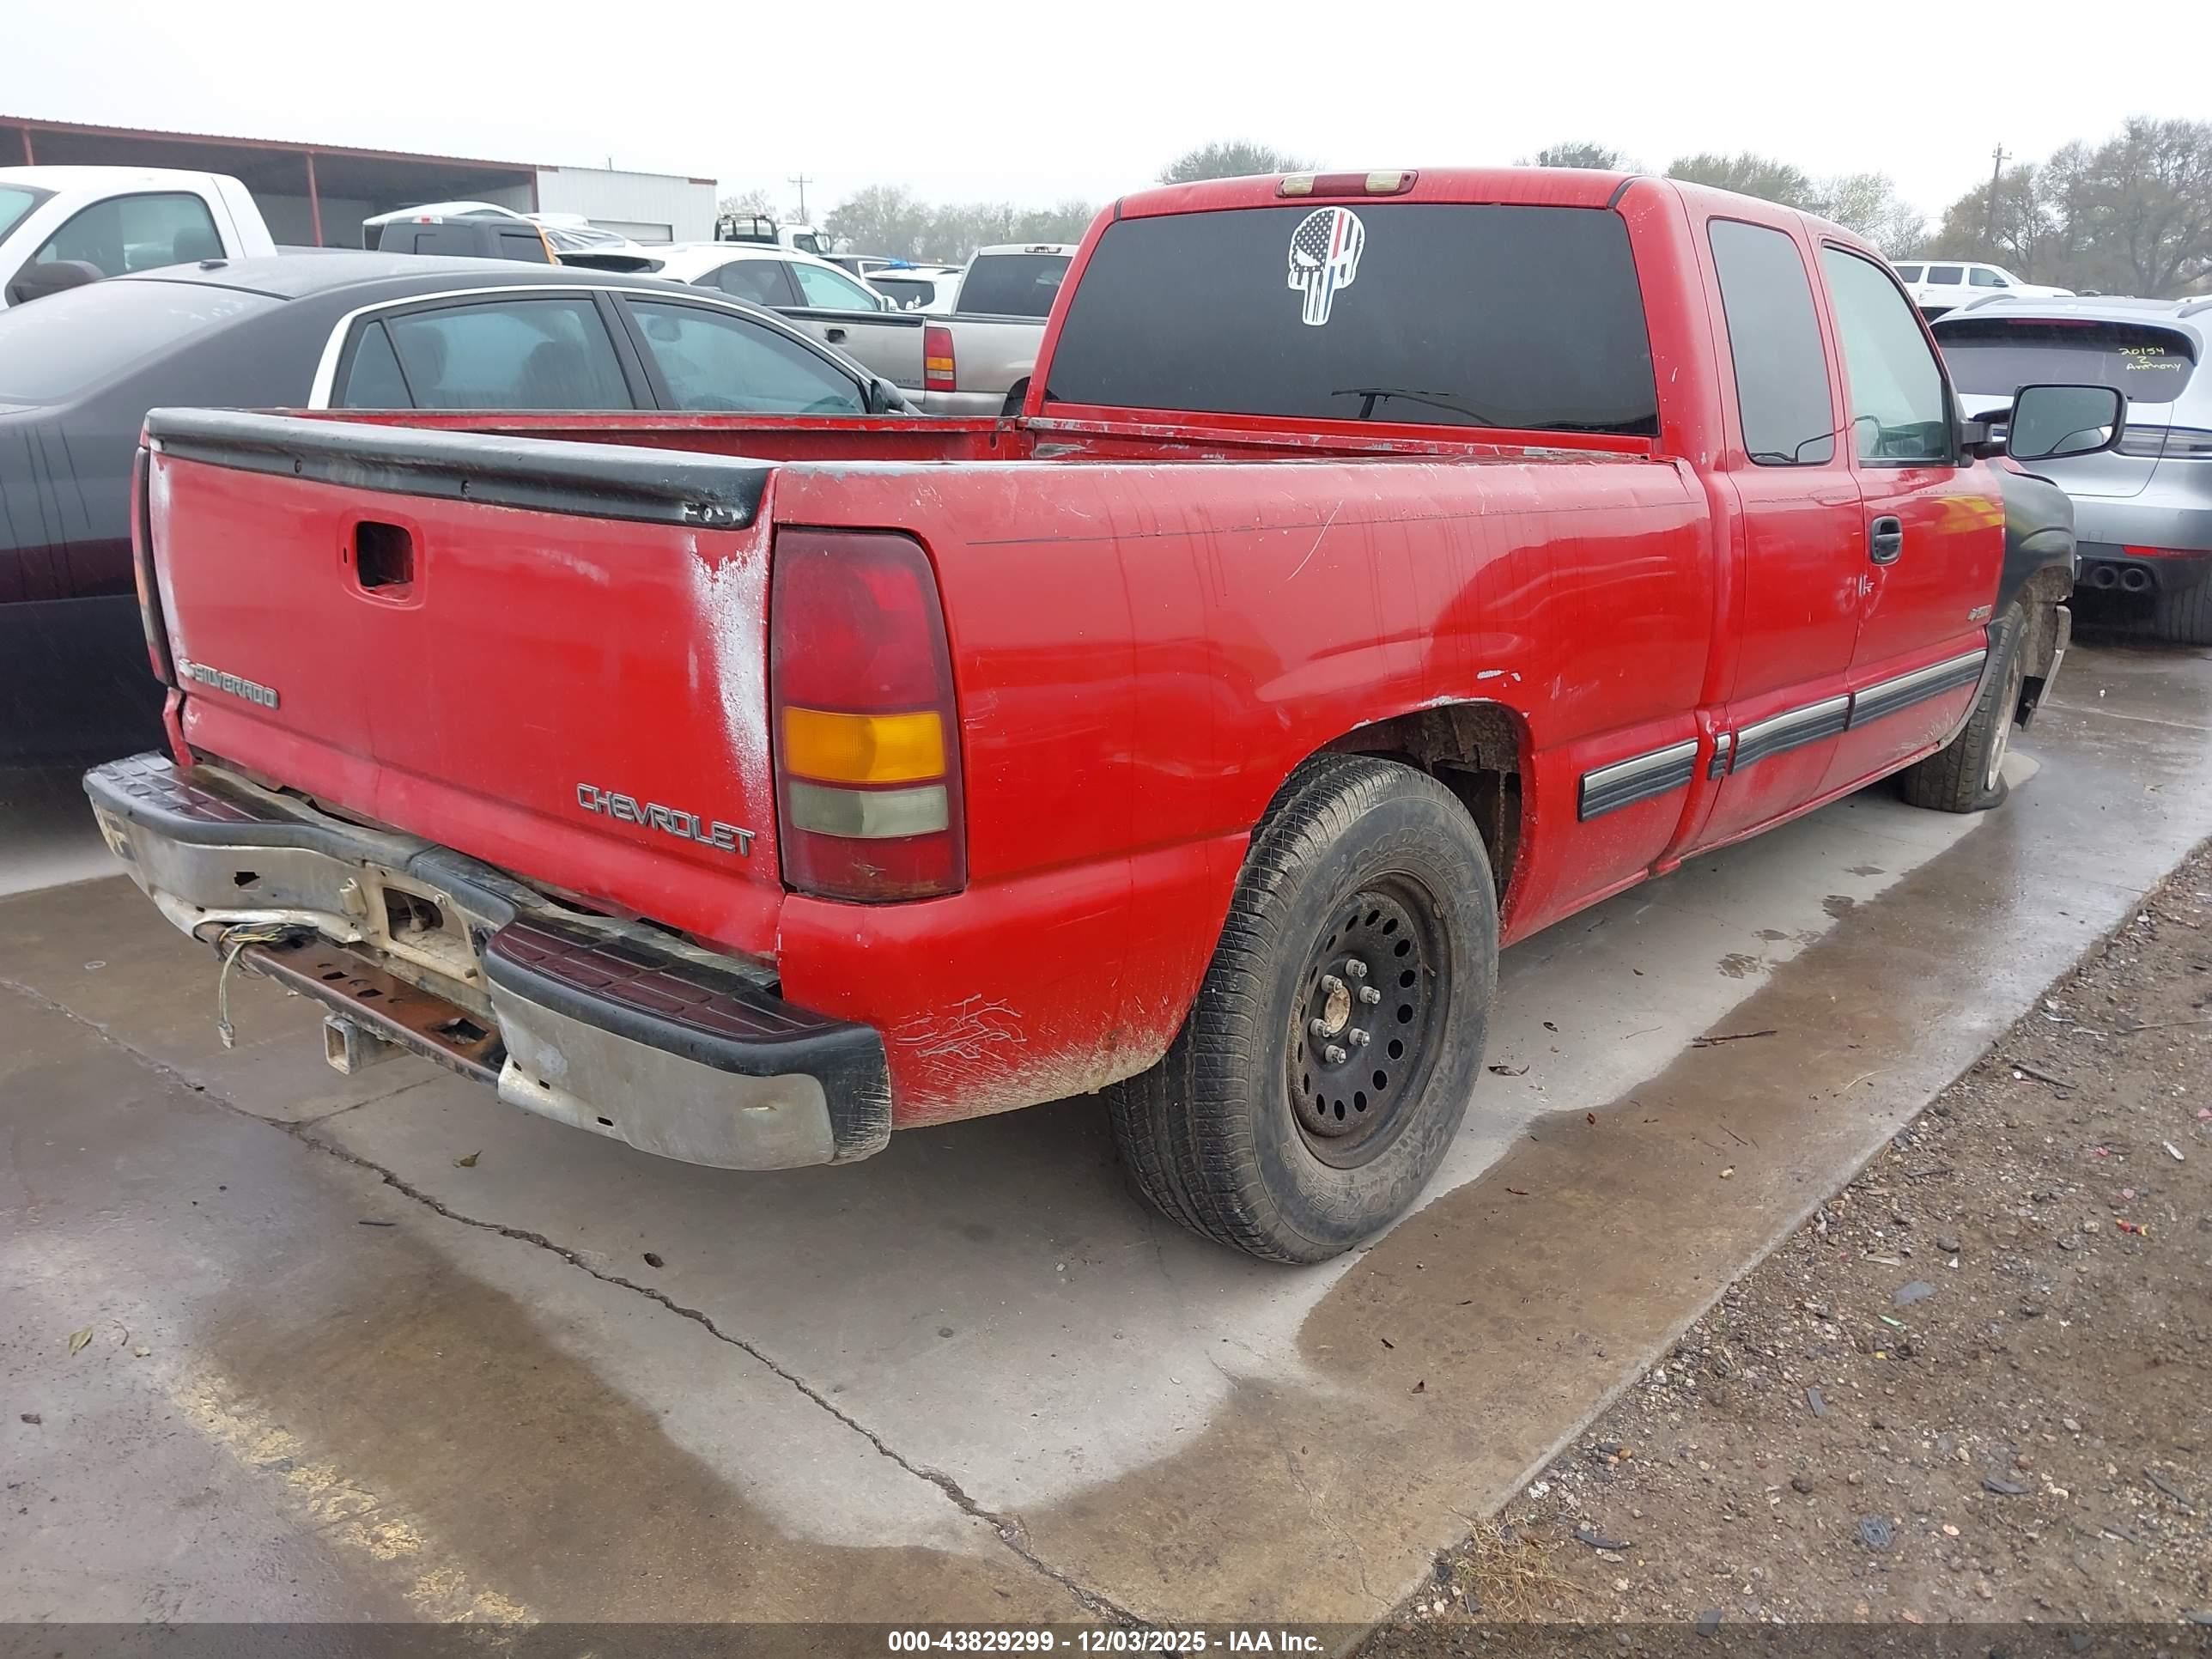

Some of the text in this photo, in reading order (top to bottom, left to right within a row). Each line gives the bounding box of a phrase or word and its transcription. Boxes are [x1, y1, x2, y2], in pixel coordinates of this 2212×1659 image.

[2118, 347, 2165, 356] 20154
[2125, 362, 2182, 372] Anthony
[194, 662, 279, 710] SILVERADO
[576, 782, 757, 857] CHEVROLET
